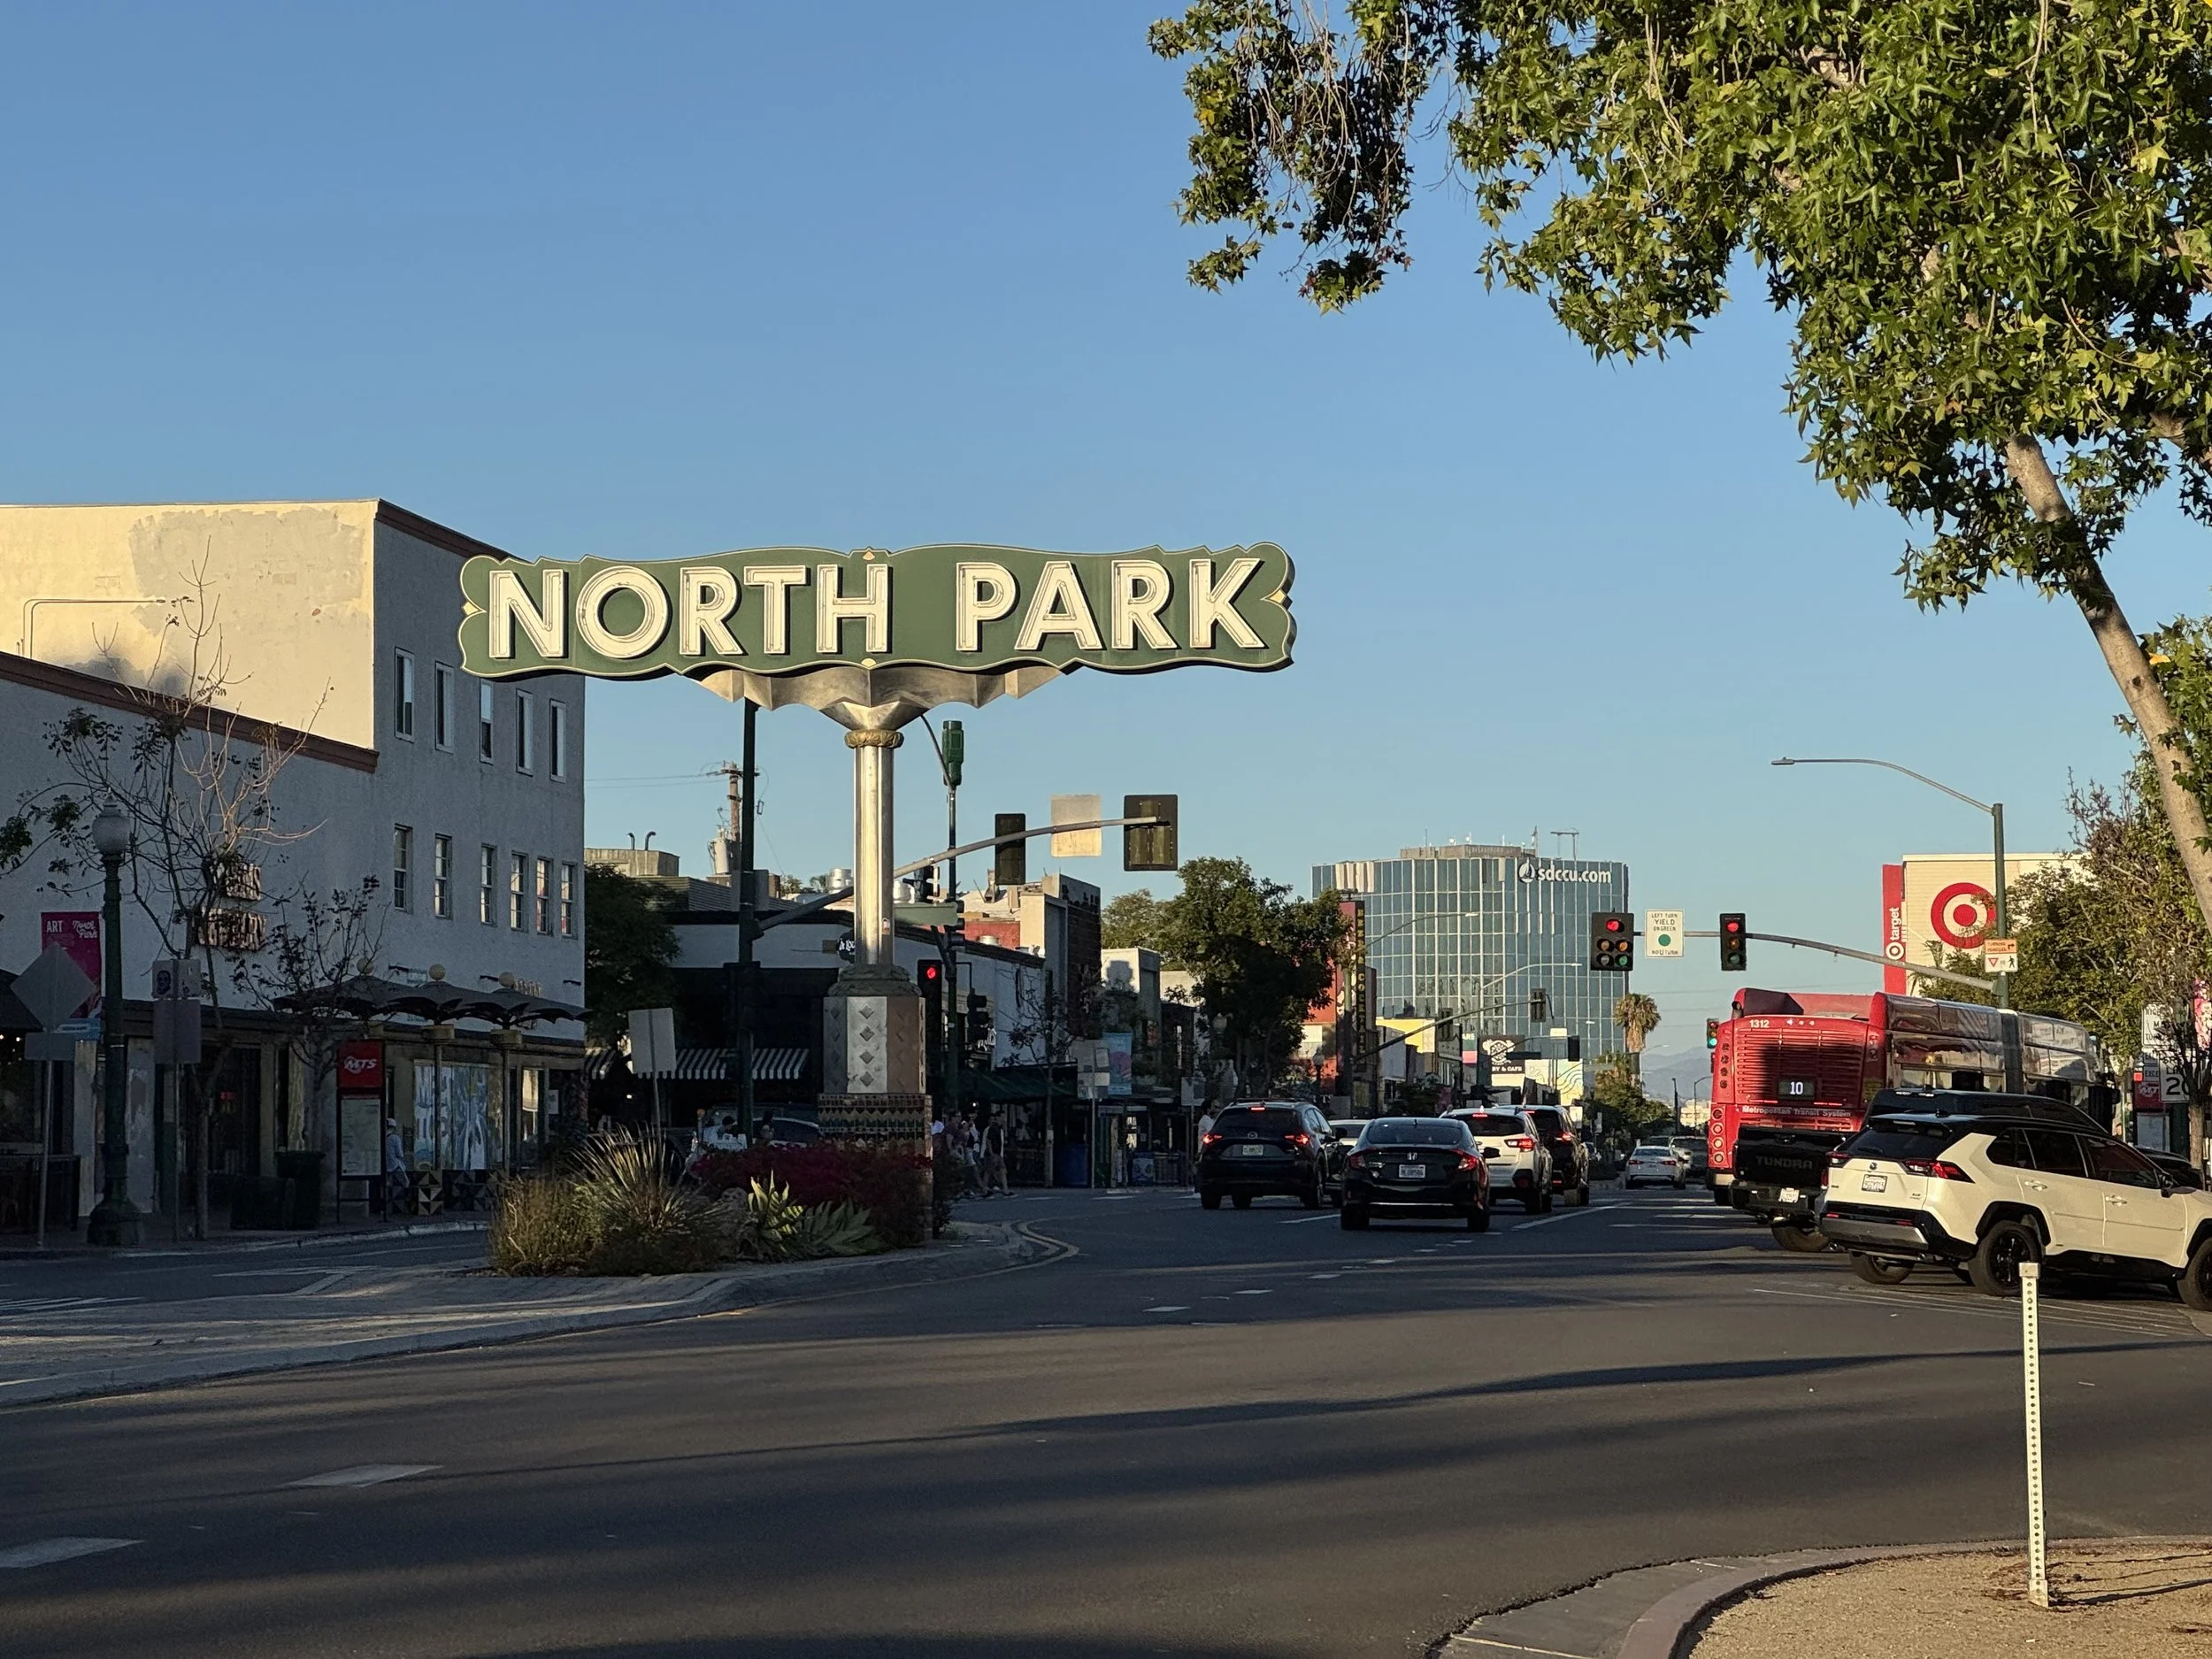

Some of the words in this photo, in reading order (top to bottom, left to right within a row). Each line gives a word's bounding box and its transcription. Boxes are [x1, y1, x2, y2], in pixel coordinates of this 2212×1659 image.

[488, 563, 889, 659] NORTH
[956, 557, 1266, 652] PARK
[1538, 864, 1611, 884] sdccu.com
[46, 920, 63, 933] ART
[1889, 907, 1901, 941] target
[1749, 1019, 1770, 1028] 1312
[345, 1057, 377, 1071] MTS
[1790, 1081, 1803, 1094] 10
[1742, 1105, 1791, 1115] Metropolitan
[1822, 1109, 1851, 1118] System
[1755, 1156, 1813, 1169] TUNDRA
